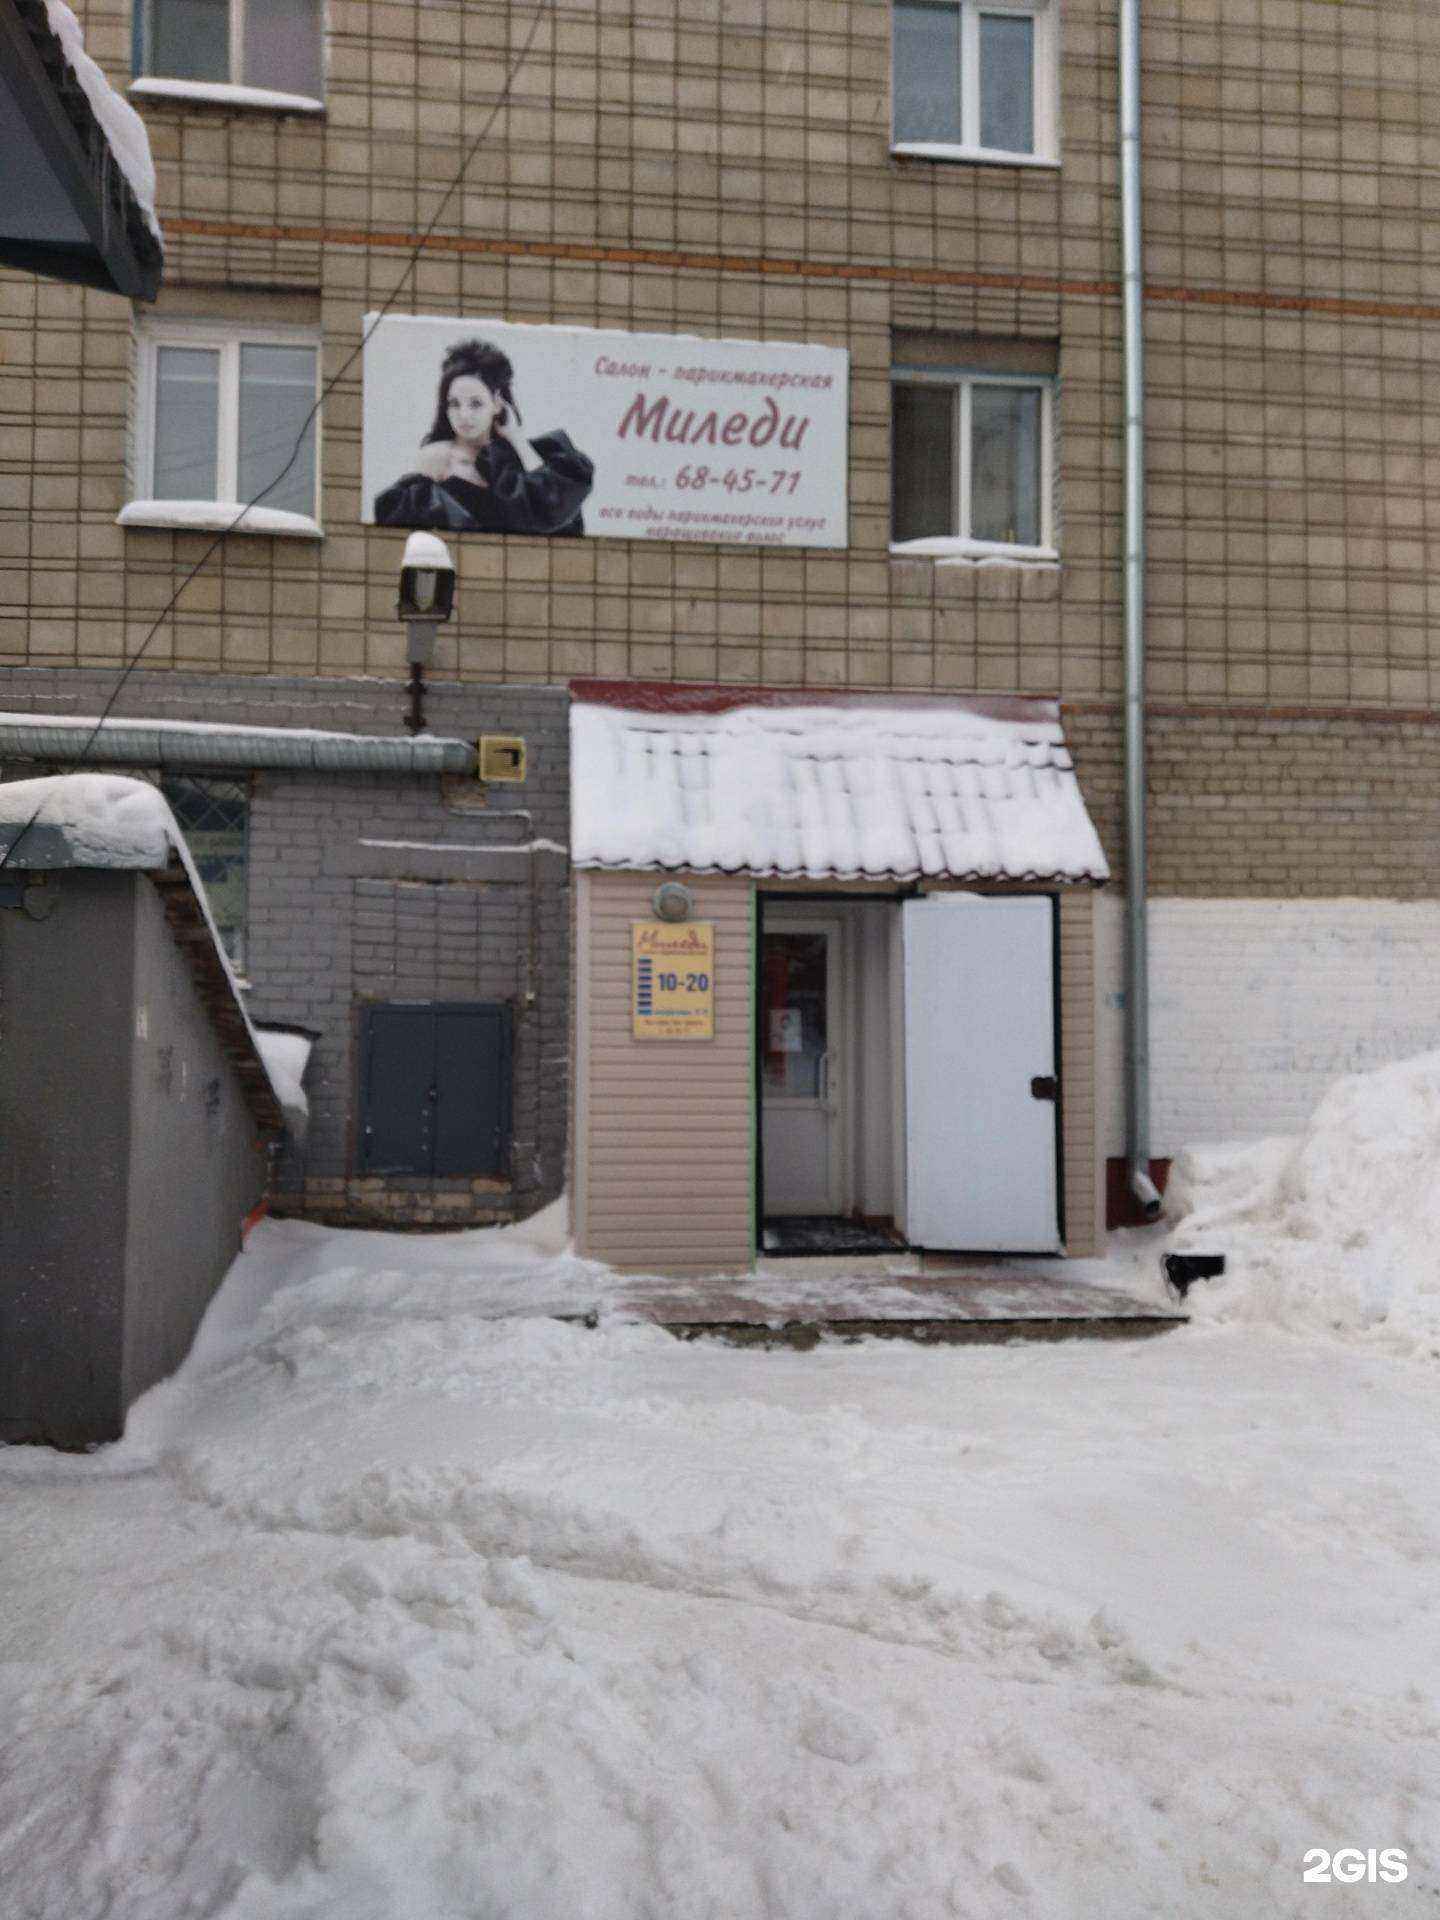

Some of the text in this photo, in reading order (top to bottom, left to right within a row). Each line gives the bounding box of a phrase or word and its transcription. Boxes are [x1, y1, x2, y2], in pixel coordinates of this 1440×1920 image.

[595, 356, 651, 378] Салон
[674, 366, 833, 390] парикмахерская
[617, 393, 810, 450] Миледи
[675, 464, 801, 494] 68-45-71
[658, 973, 709, 992] 10-20
